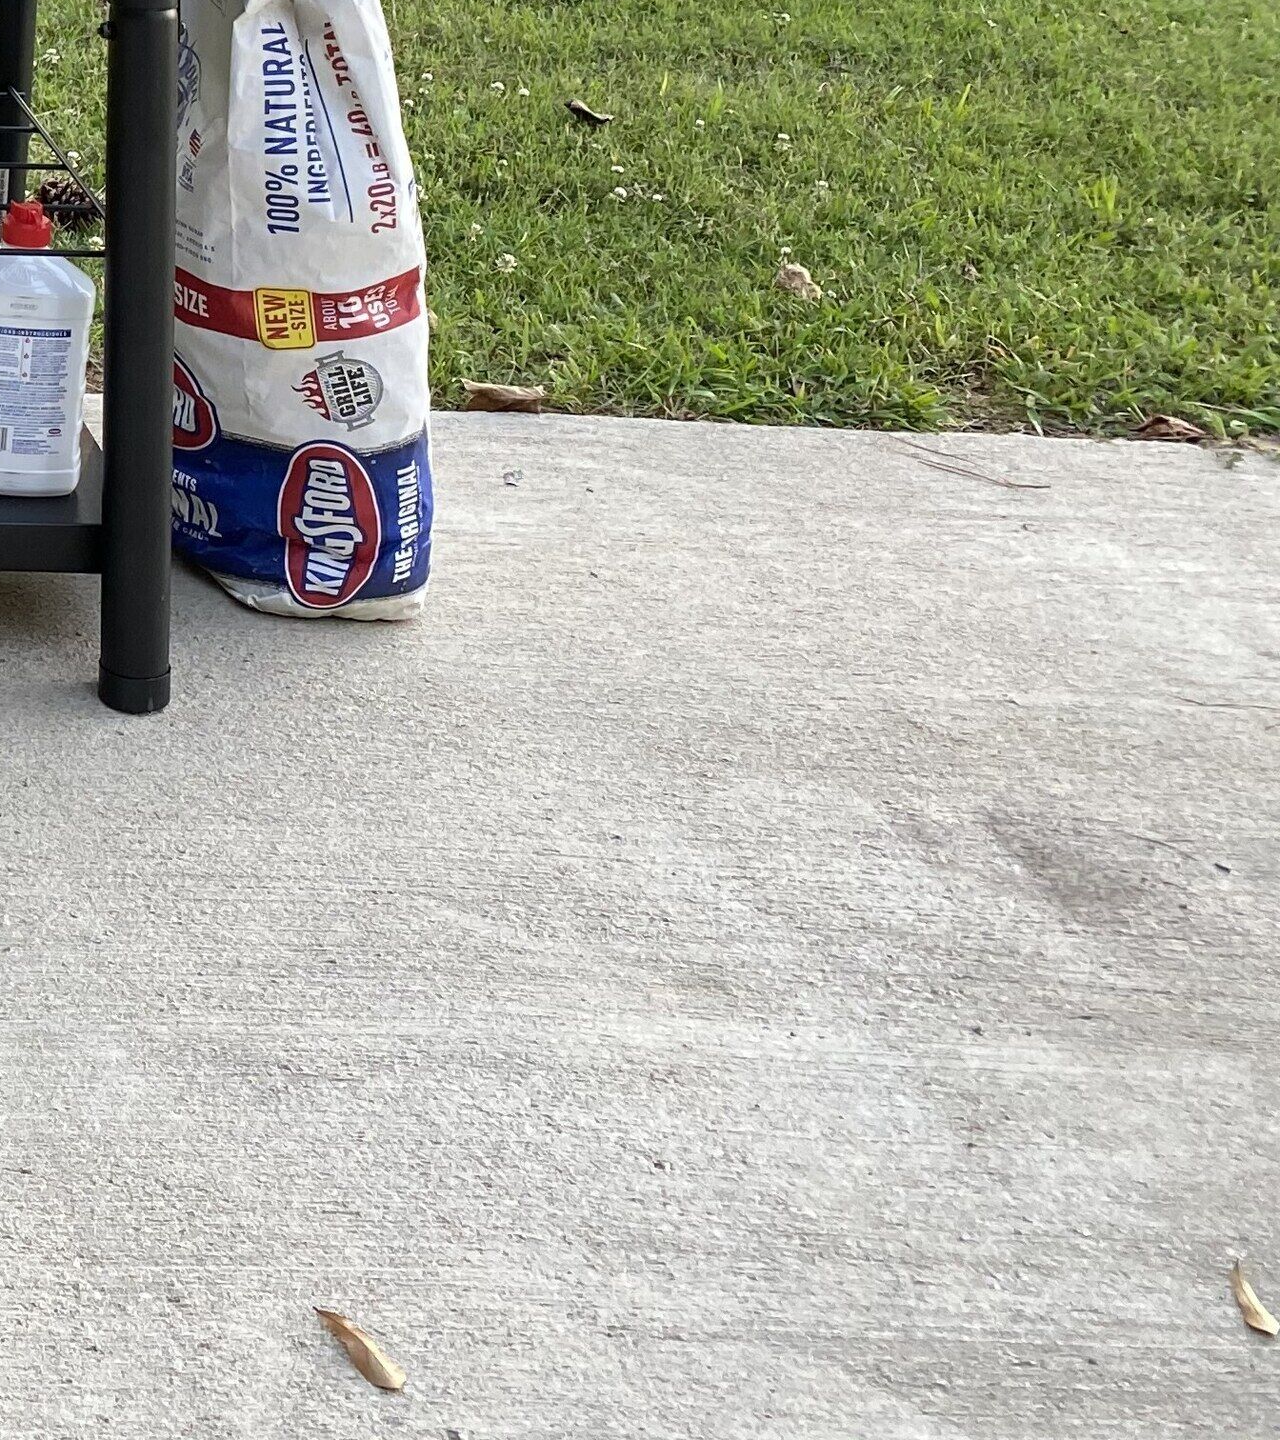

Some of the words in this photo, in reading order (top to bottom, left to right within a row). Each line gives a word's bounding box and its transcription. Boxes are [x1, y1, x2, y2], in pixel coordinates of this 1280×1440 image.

[261, 21, 298, 155] NATURAL
[265, 164, 300, 234] 100%
[174, 281, 209, 318] SIZE
[262, 293, 290, 340] NEW
[288, 298, 307, 332] SIZE
[365, 284, 391, 329] USES
[328, 365, 356, 418] GRILL
[346, 366, 374, 407] LIFE
[293, 459, 364, 597] KINGSFORD
[392, 546, 413, 583] THE
